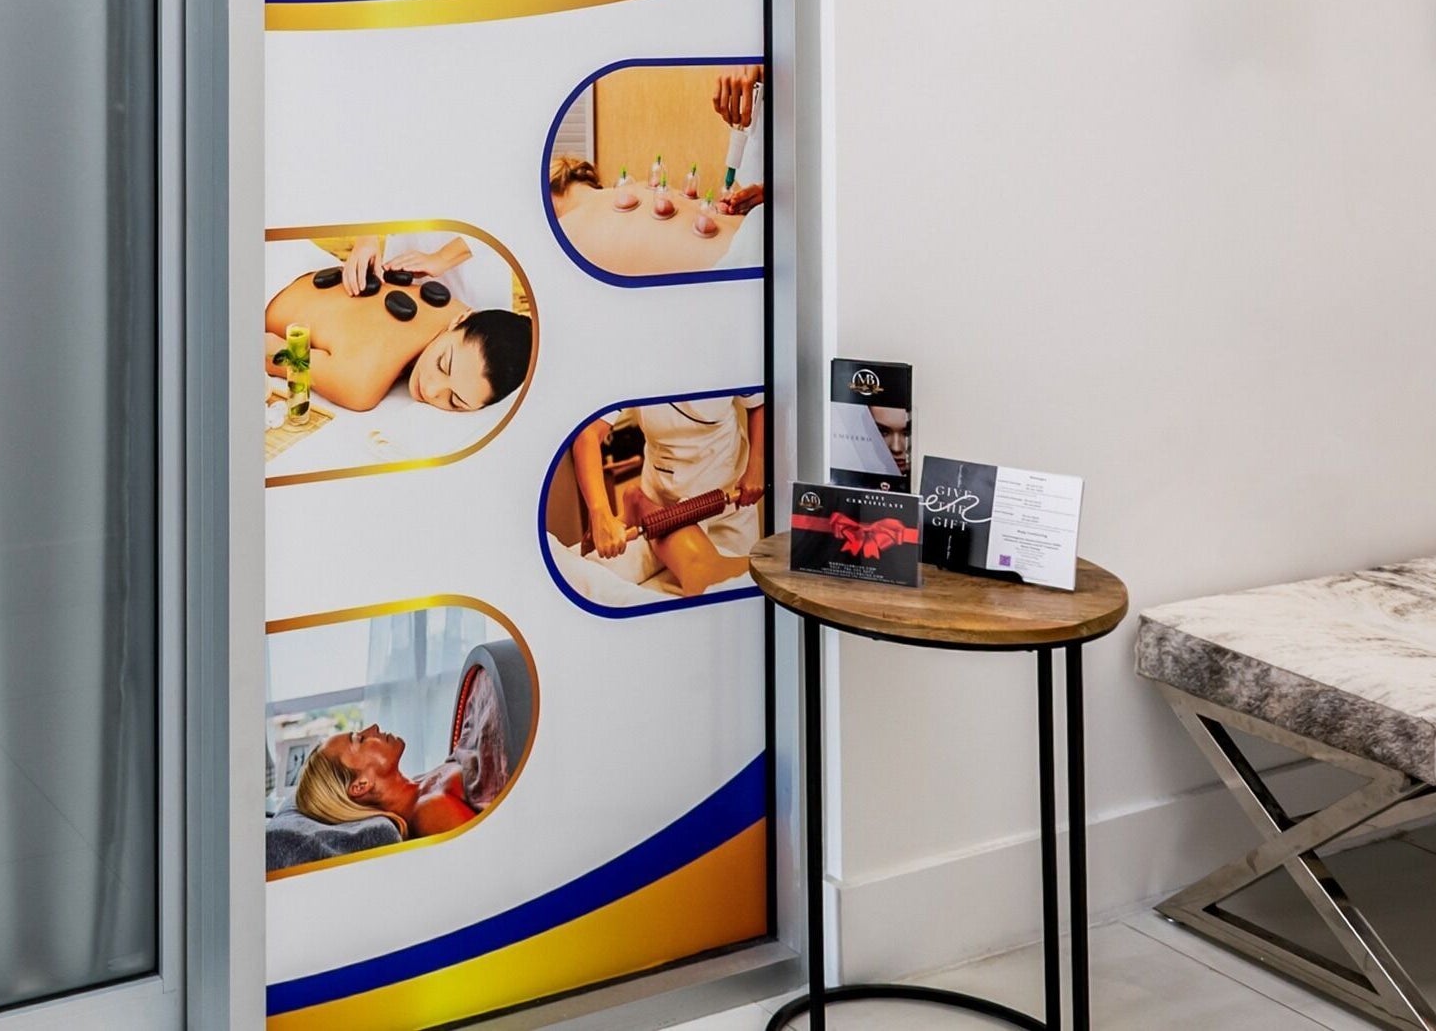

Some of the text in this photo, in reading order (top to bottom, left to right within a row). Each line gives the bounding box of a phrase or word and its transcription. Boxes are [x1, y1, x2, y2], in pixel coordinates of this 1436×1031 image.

[857, 373, 875, 385] MB
[935, 486, 972, 500] GIVE
[932, 516, 968, 531] GIFT
